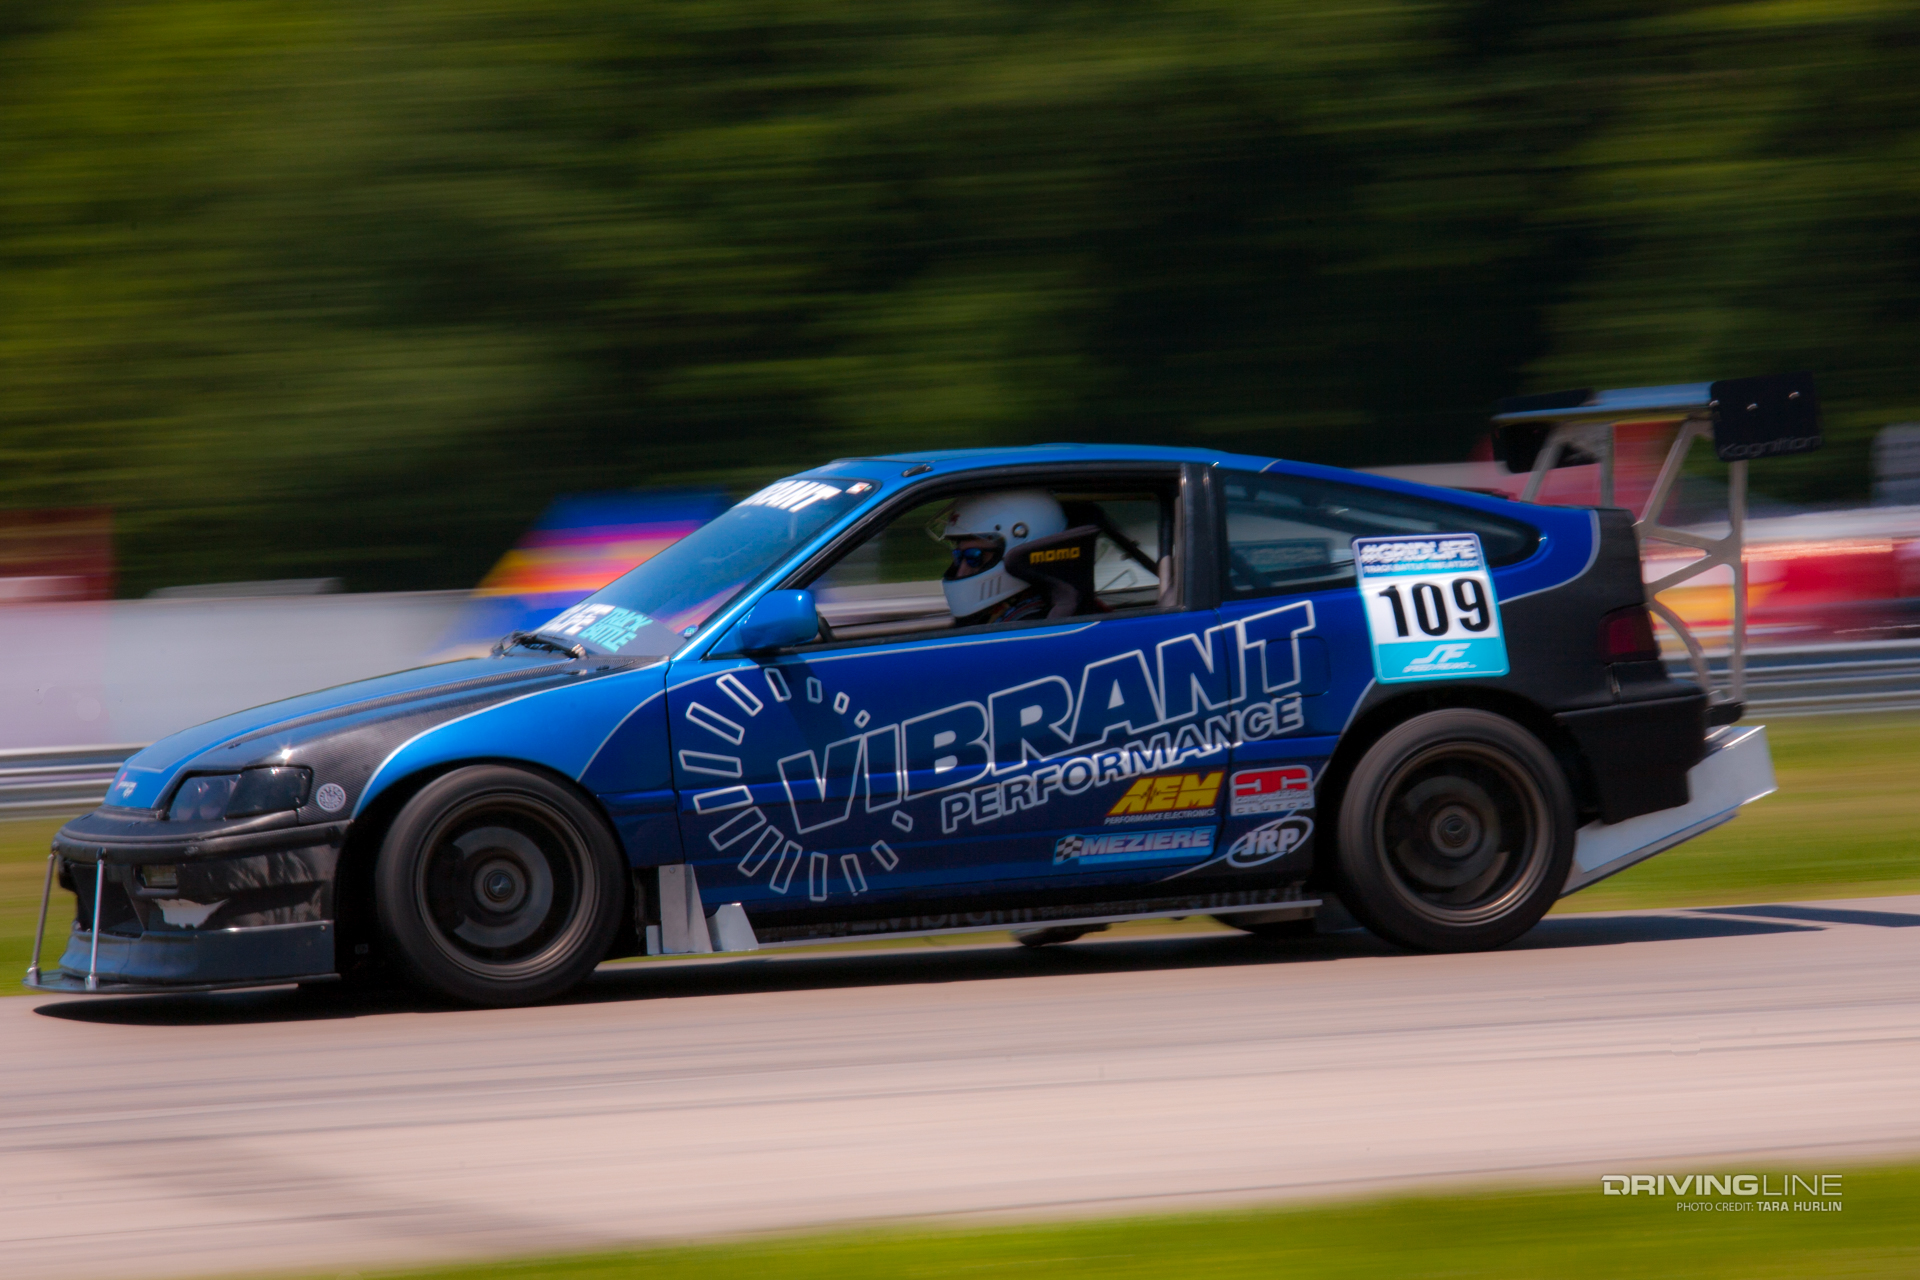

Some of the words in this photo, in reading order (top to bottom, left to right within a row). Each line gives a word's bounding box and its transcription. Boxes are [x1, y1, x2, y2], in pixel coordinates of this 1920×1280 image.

[1360, 540, 1478, 565] #GRIDLIFE
[600, 606, 654, 633] TRACK
[1379, 577, 1490, 637] 109
[577, 620, 637, 653] BATTLE
[777, 600, 1316, 834] VIBRANT
[941, 691, 1304, 834] PERFORMANCE
[1106, 771, 1225, 817] AEM
[1235, 801, 1311, 814] CLUTCH
[1104, 812, 1164, 826] PERFORMANCE
[1164, 808, 1217, 821] ELECTRONICS
[1079, 827, 1213, 857] MEZIERE
